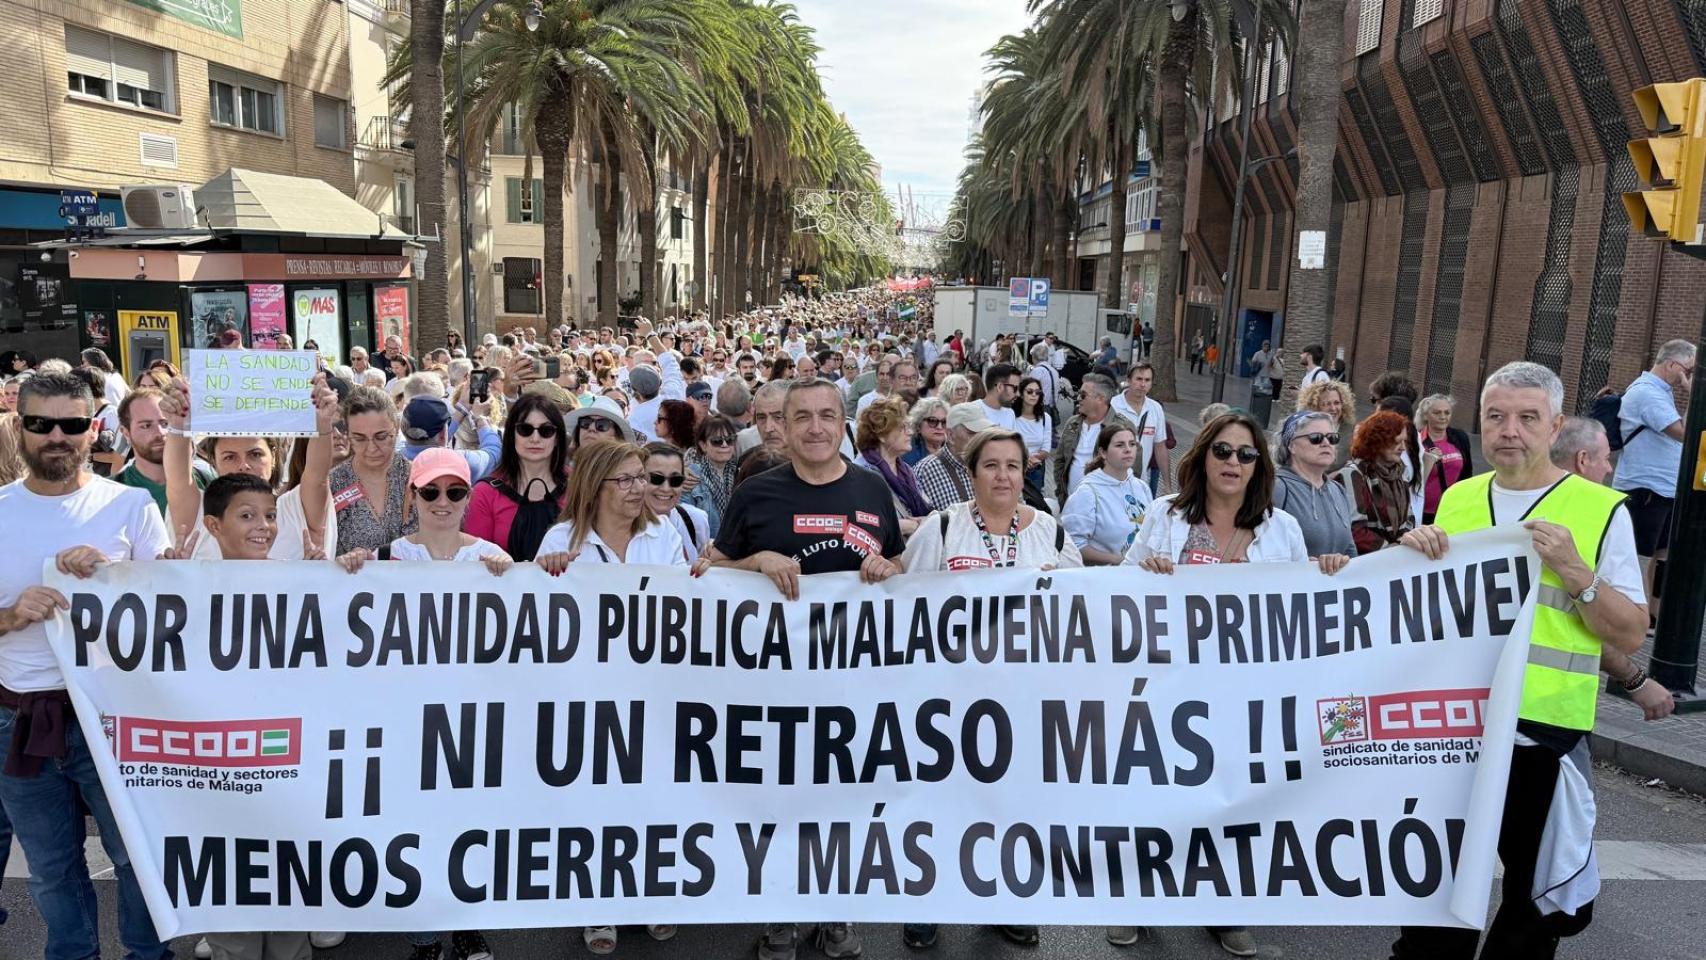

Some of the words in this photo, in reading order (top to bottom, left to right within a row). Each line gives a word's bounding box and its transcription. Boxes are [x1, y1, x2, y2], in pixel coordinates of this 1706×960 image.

[73, 196, 97, 204] ATM
[1031, 281, 1047, 300] P
[138, 315, 170, 328] ATM
[205, 354, 229, 369] LA
[240, 354, 311, 371] SANIDAD
[206, 374, 231, 391] NO
[241, 376, 264, 390] SE
[272, 377, 312, 390] VENDE
[203, 394, 225, 410] SE
[796, 517, 834, 527] CCOO
[848, 527, 877, 550] CCOO
[802, 539, 838, 557] LUTO
[843, 540, 868, 558] POR
[71, 592, 187, 672] POR
[210, 594, 327, 671] UNA
[347, 592, 580, 667] SANIDAD
[598, 566, 792, 671] PÚBLICA
[809, 577, 1096, 670] MALAGUEÑA
[1113, 595, 1172, 664] DE
[1185, 586, 1372, 664] PRIMER
[1380, 700, 1487, 730] CCO
[131, 727, 257, 757] CCOO
[421, 702, 504, 790] NI
[536, 701, 645, 787] UN
[674, 699, 1013, 787] RETRASO
[1042, 678, 1214, 787] MÁS
[1249, 696, 1301, 783] !!
[1323, 741, 1387, 757] sindicato
[1391, 740, 1410, 752] de
[1414, 738, 1473, 751] sanidad
[1324, 753, 1437, 768] sociosanitarios
[1441, 752, 1461, 764] de
[140, 763, 158, 775] de
[162, 766, 217, 779] sanidad
[222, 770, 230, 782] y
[234, 769, 298, 780] sectores
[187, 779, 205, 789] de
[210, 781, 263, 794] Málaga
[164, 830, 421, 909] MENOS
[448, 823, 715, 904] CIERRES
[736, 823, 776, 895] Y
[798, 803, 936, 897] MÁS
